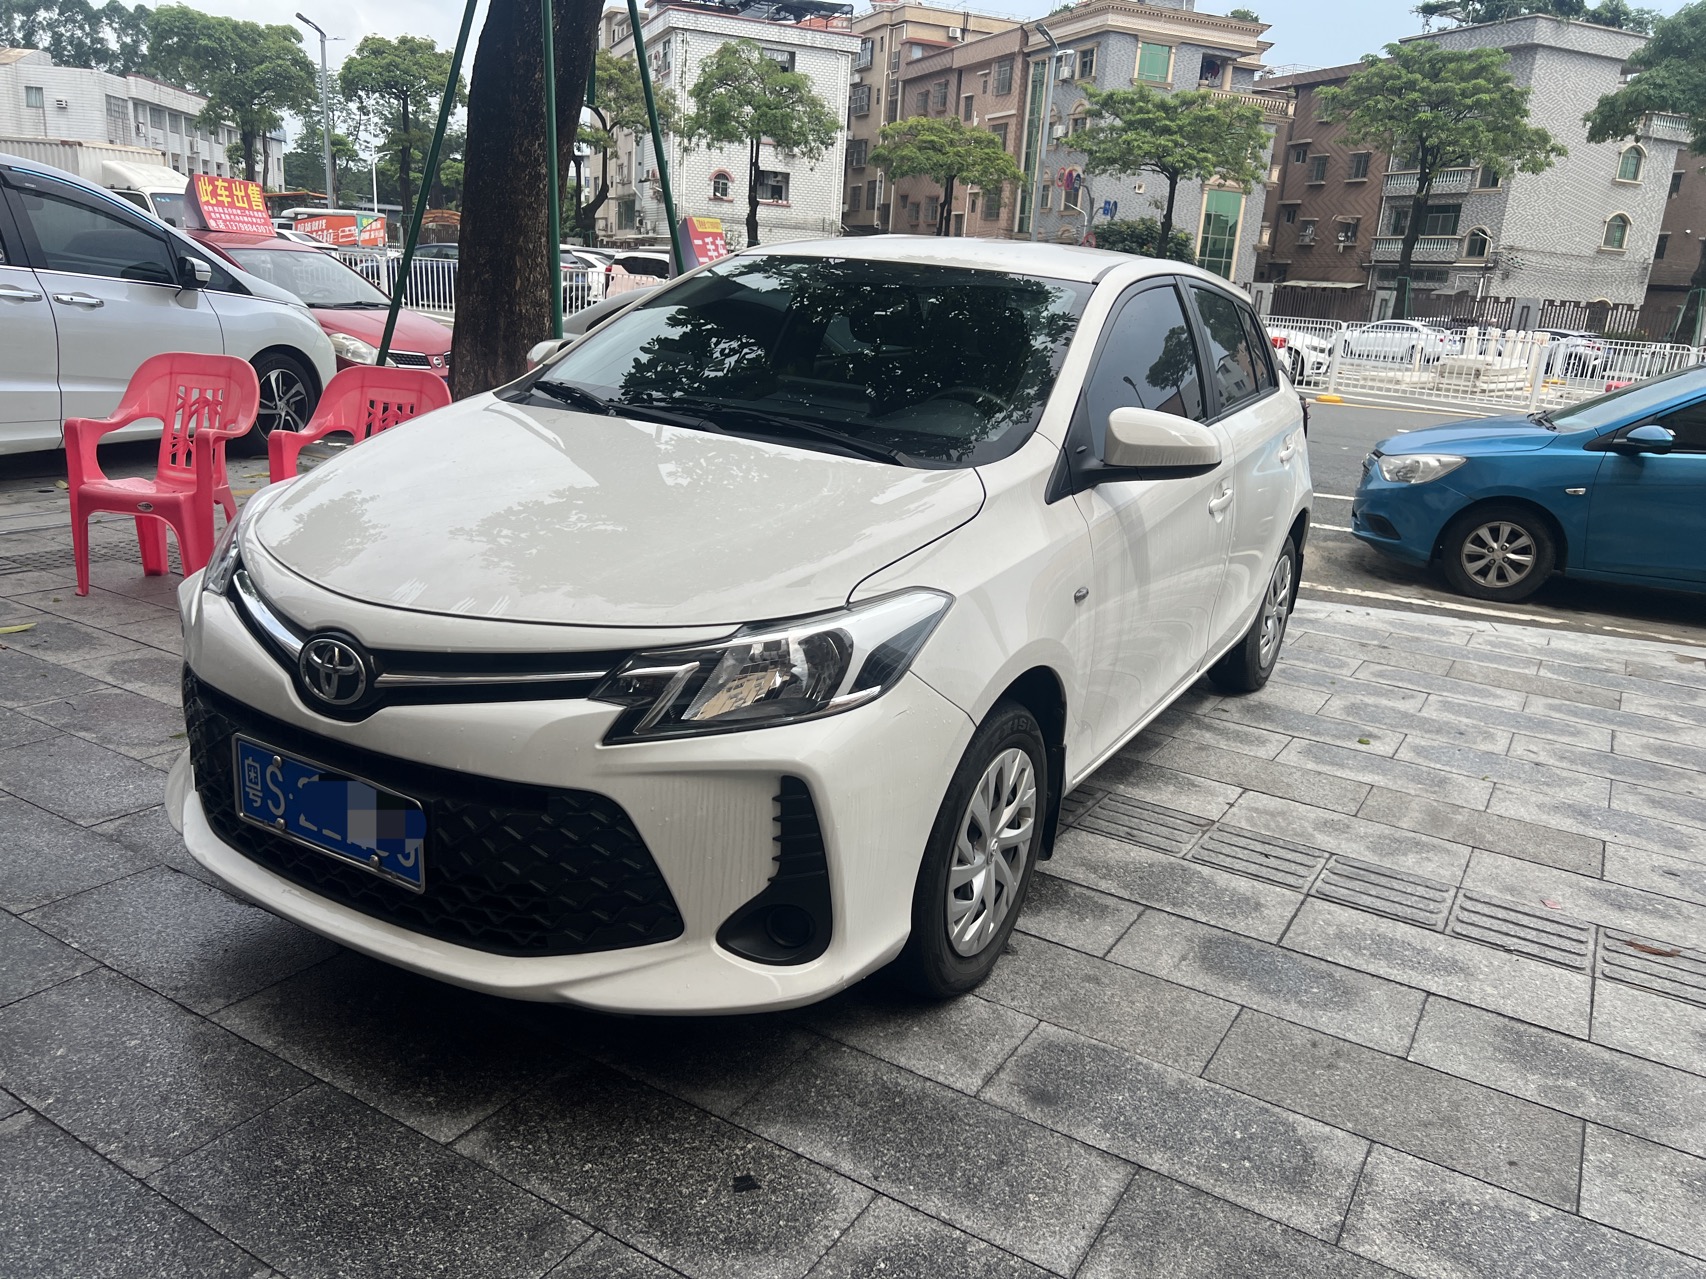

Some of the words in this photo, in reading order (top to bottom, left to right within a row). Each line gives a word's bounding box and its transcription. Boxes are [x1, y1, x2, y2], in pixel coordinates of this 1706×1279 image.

[199, 177, 263, 210] 此车出售
[693, 236, 728, 262] 二手车
